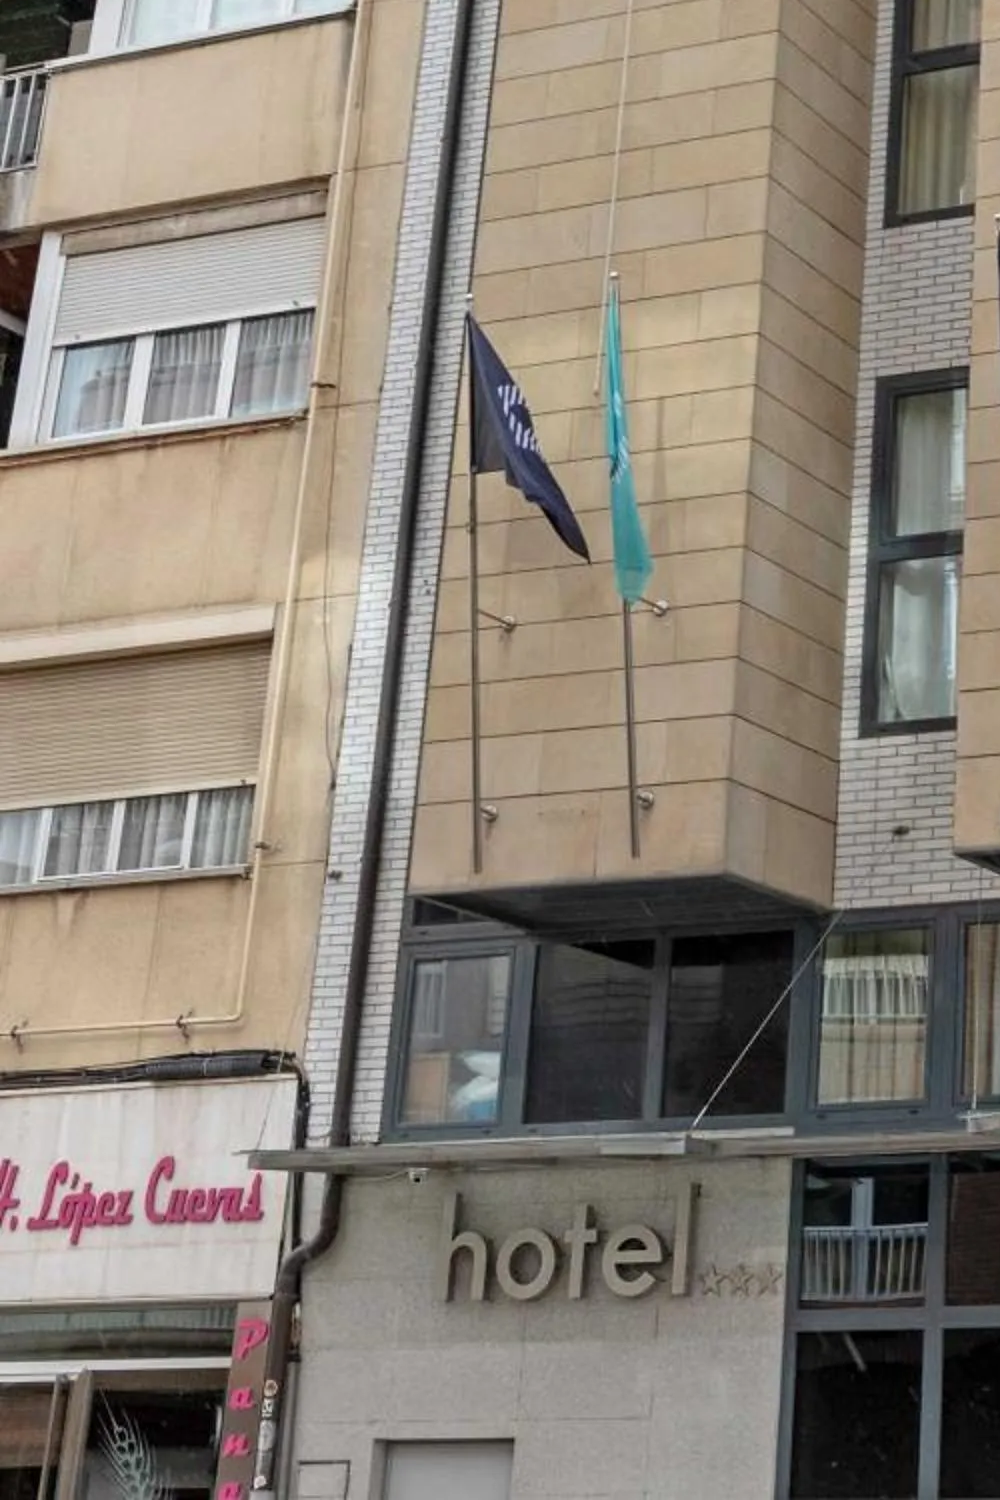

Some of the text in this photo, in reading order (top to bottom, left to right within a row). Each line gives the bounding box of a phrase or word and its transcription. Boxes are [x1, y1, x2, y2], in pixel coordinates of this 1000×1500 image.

[27, 1161, 134, 1246] López
[145, 1156, 264, 1224] Cuevas
[436, 1182, 695, 1301] hotel
